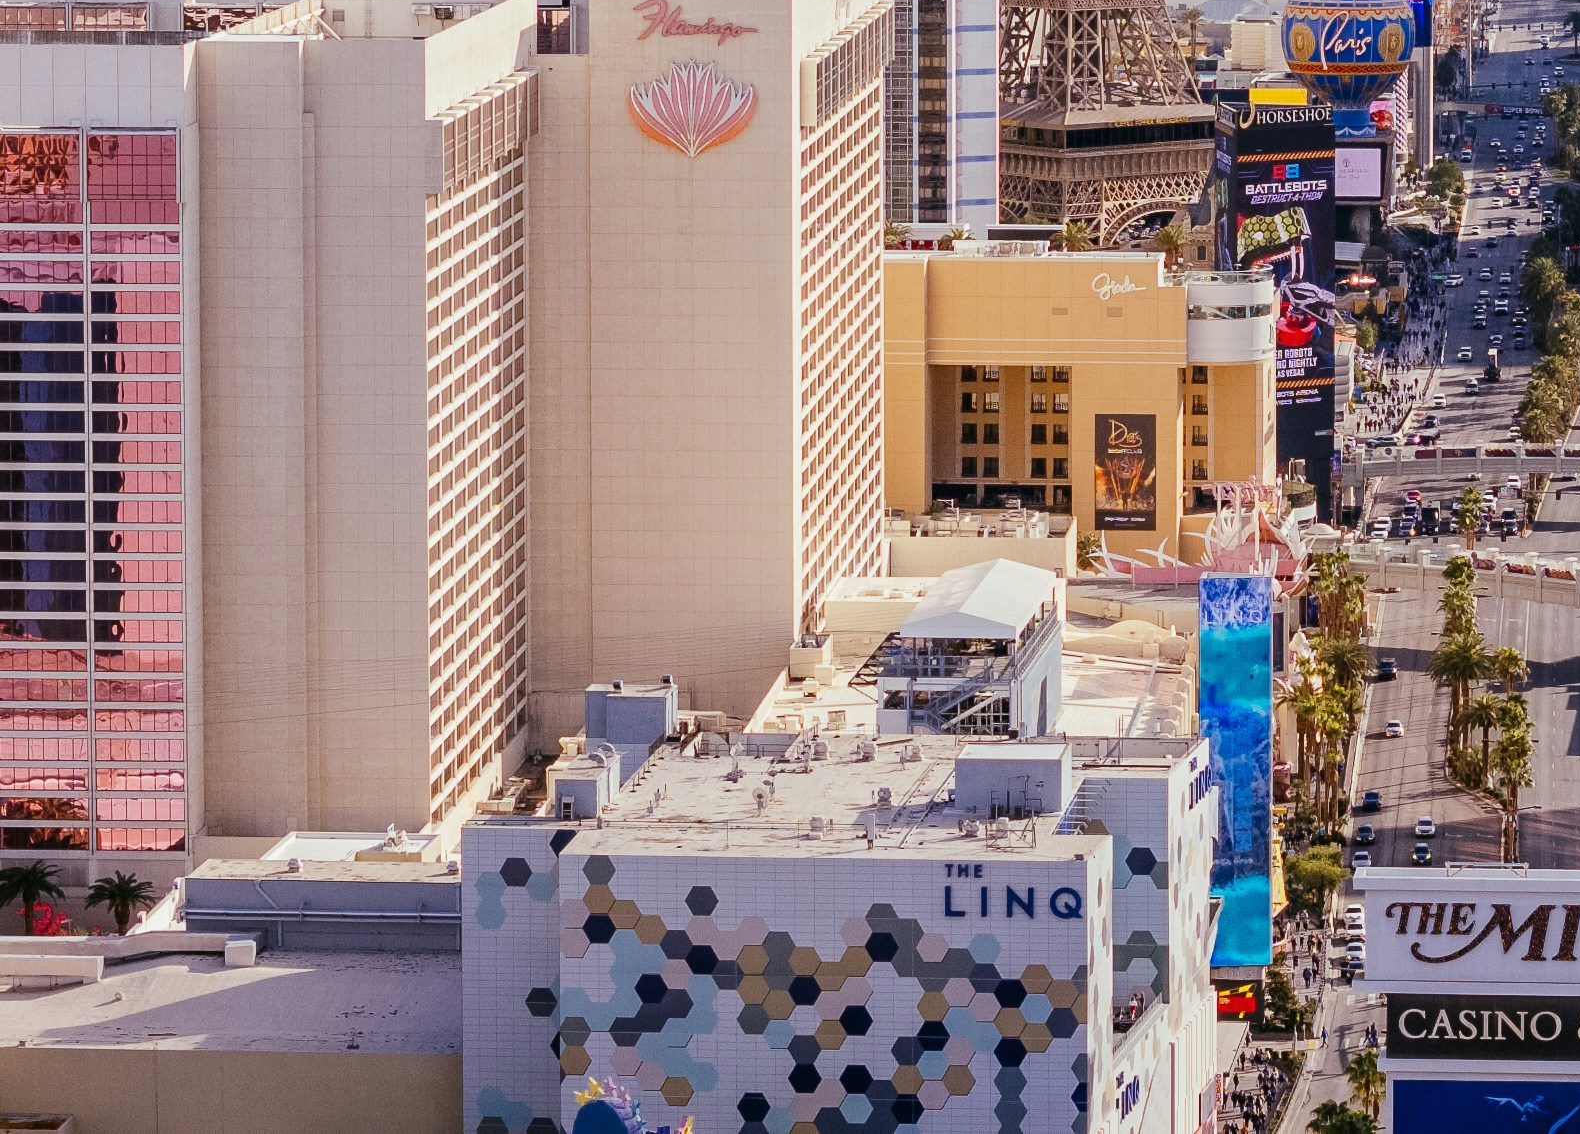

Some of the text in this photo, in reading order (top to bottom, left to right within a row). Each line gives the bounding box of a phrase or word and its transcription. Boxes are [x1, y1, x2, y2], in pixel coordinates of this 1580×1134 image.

[1321, 10, 1372, 71] Paris
[1257, 107, 1332, 125] HORSESHOE
[1245, 179, 1328, 195] BATTLEBOTS
[1250, 191, 1324, 205] DESTRUCT-A-THON
[1284, 347, 1313, 359] ROBOTS
[1289, 357, 1318, 368] NIGHTLY
[1286, 368, 1305, 377] VEGAS
[1204, 610, 1263, 624] LINQ
[944, 863, 983, 878] THE
[944, 885, 1084, 919] LINQ
[1385, 901, 1477, 936] THE
[1398, 1008, 1562, 1043] CASINO
